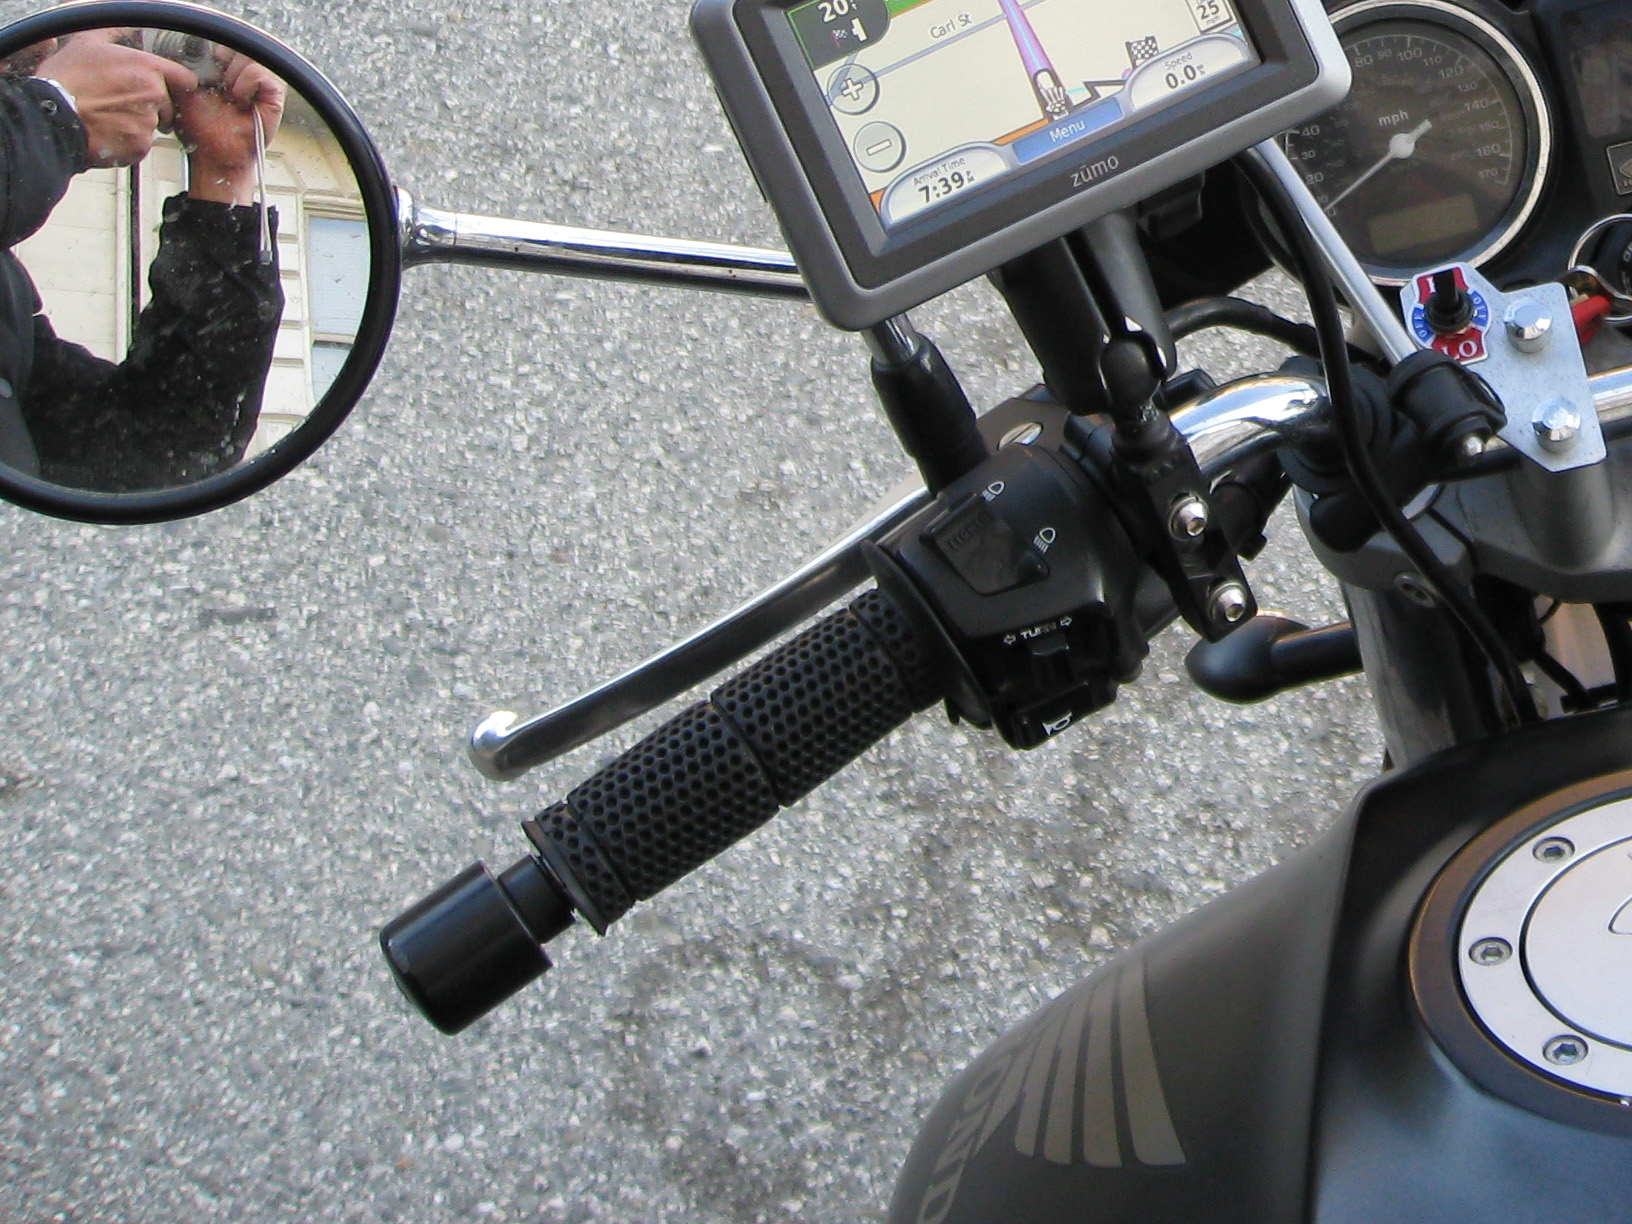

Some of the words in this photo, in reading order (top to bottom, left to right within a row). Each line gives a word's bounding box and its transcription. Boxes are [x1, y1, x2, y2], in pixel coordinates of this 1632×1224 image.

[1196, 0, 1220, 21] 25
[929, 19, 957, 39] Carl
[958, 12, 973, 27] St
[1164, 52, 1193, 71] Speed
[1355, 54, 1374, 68] 80
[1377, 48, 1393, 60] 90
[1397, 47, 1423, 62] 100
[1423, 55, 1442, 67] 110
[1439, 64, 1465, 79] 120
[1458, 81, 1478, 92] 130
[1464, 98, 1489, 112] 140
[1378, 110, 1410, 126] mph
[1049, 119, 1087, 143] Menu
[1301, 124, 1320, 137] 40
[1301, 149, 1316, 160] 30
[1476, 142, 1501, 157] 160
[913, 167, 941, 186] Arrival
[941, 157, 967, 174] Time
[1479, 167, 1498, 180] 170
